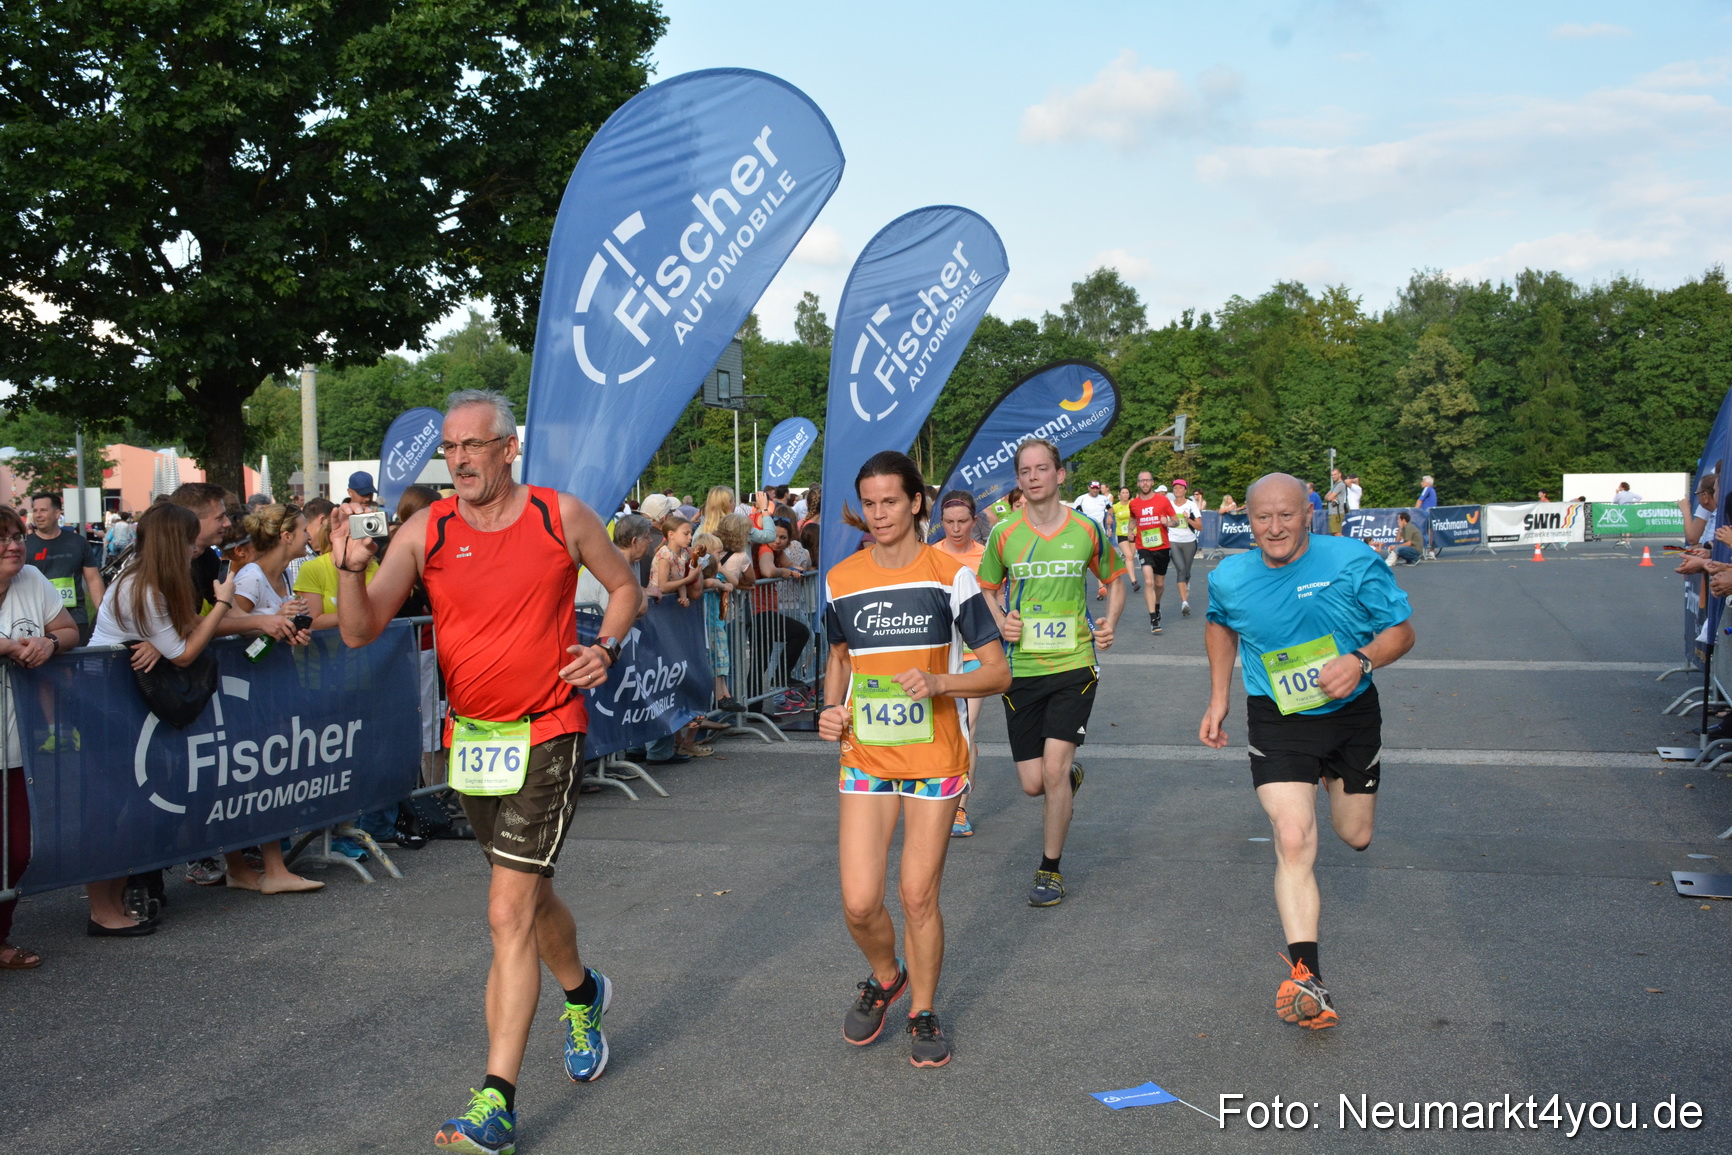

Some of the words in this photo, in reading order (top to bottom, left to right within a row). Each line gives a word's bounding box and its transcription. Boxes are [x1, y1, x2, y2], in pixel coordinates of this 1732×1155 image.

[614, 125, 778, 347] Fischer
[672, 170, 797, 346] AUTOMOBILE
[873, 241, 970, 395] Fischer
[908, 269, 980, 392] AUTOMOBILE
[1061, 426, 1078, 439] und
[1077, 405, 1110, 431] Medien
[396, 419, 435, 472] Fischer
[409, 429, 440, 471] AUTOMOBILE
[776, 426, 805, 470] Fischer
[1432, 518, 1468, 531] Frischmann
[1524, 513, 1561, 531] swn
[1598, 508, 1627, 523] AOK
[1636, 509, 1684, 518] GESUNDHE
[1145, 535, 1158, 543] 948
[1350, 524, 1399, 537] Fische
[1012, 560, 1085, 580] BOCK
[60, 589, 73, 599] 92
[867, 612, 933, 629] Fischer
[873, 627, 928, 636] AUTOMOBILE
[1033, 622, 1067, 638] 142
[1279, 664, 1325, 695] 108
[861, 702, 924, 726] 1430
[187, 715, 362, 793] Fischer
[458, 746, 520, 772] 1376
[205, 769, 352, 825] AUTOMOBILE
